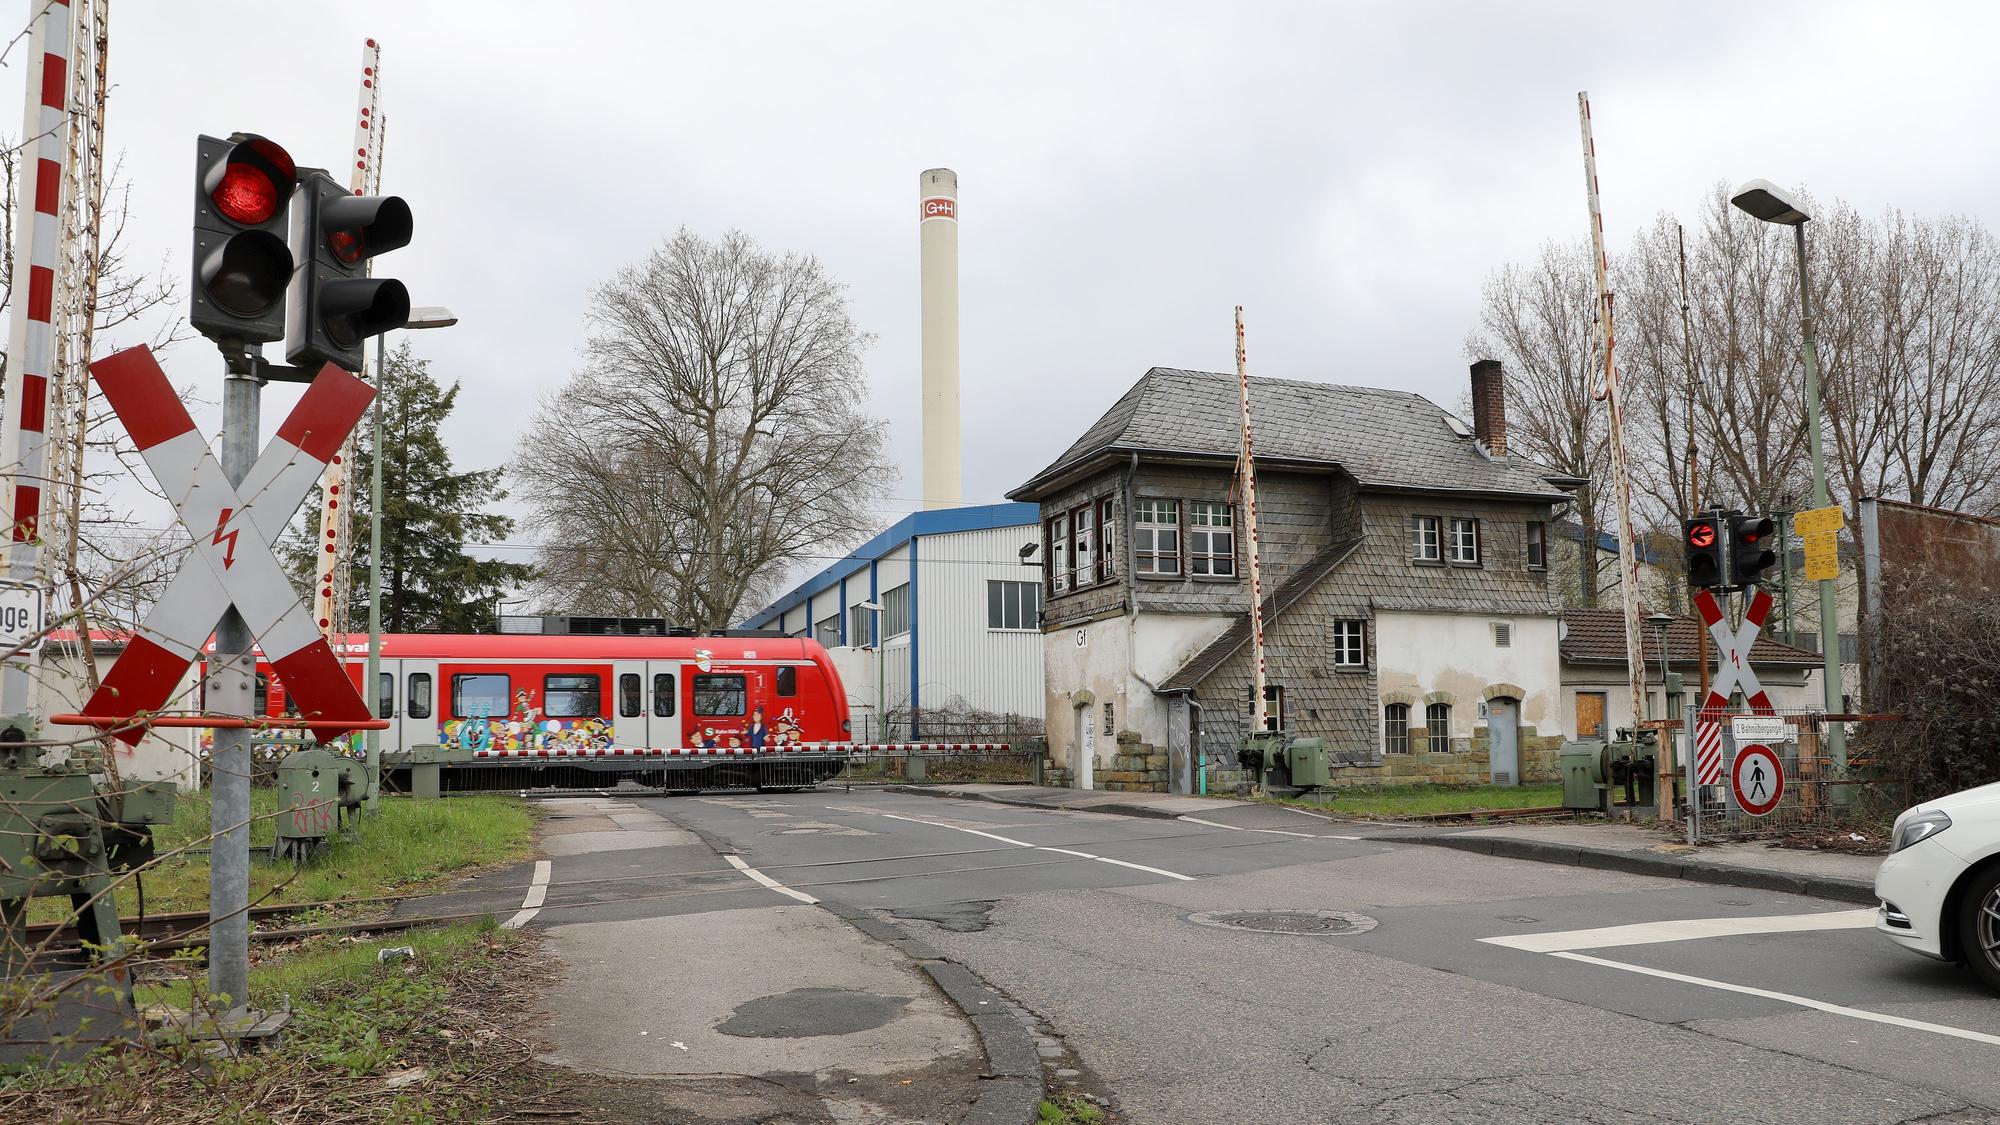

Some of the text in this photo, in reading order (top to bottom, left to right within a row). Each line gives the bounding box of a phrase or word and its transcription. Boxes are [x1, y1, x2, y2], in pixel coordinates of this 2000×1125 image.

[926, 202, 953, 215] G+H
[1077, 629, 1086, 646] Gf
[756, 674, 763, 687] 1
[1736, 724, 1740, 733] 2
[312, 781, 320, 792] 2
